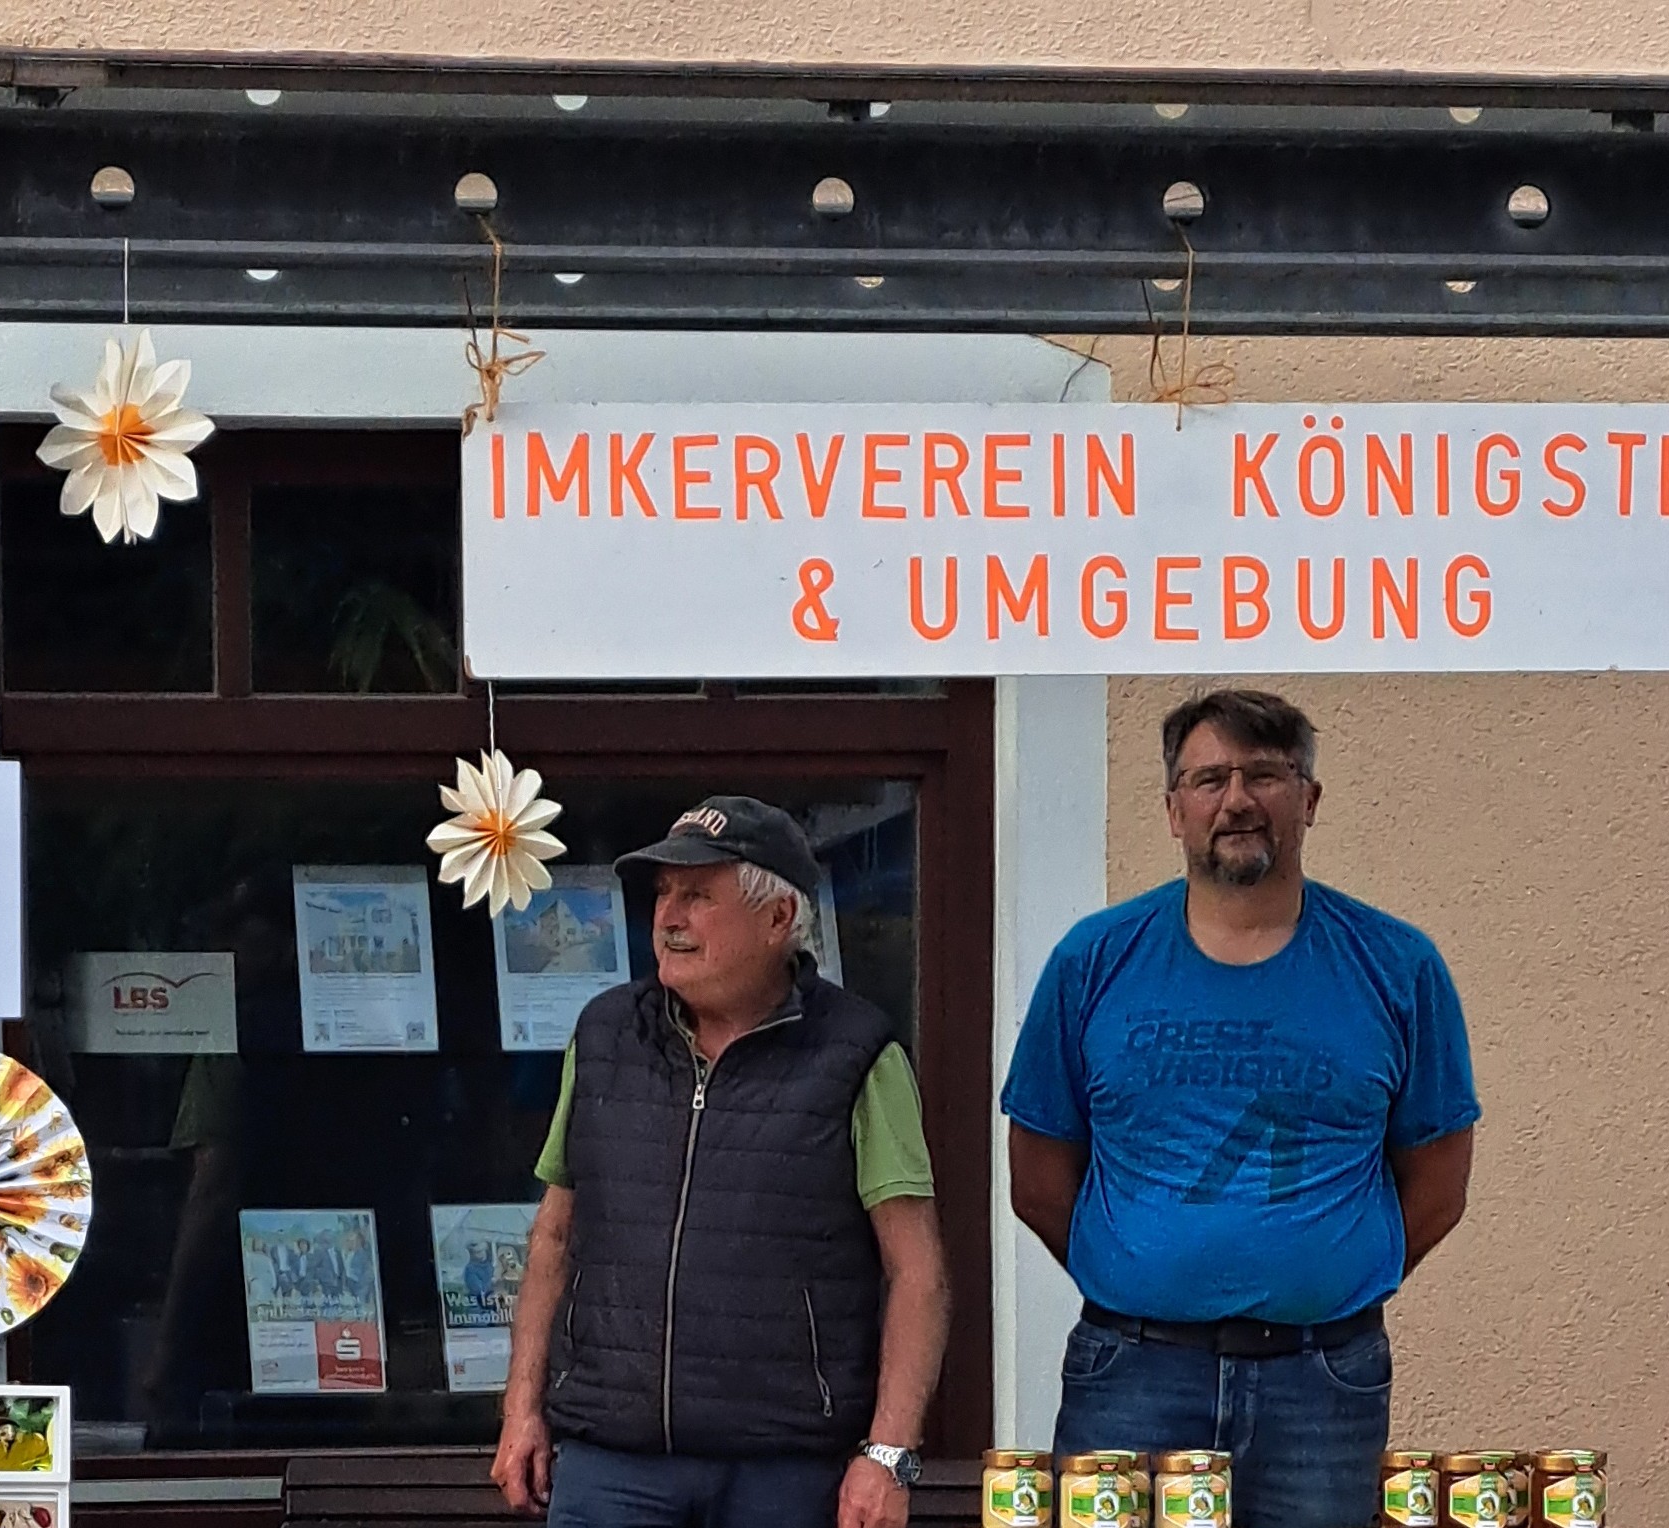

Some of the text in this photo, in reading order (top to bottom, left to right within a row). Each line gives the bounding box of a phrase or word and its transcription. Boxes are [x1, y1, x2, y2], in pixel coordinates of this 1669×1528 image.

[492, 432, 1135, 519] IMKERVEREIN
[792, 554, 1493, 641] & UMGEBUNG
[113, 986, 169, 1008] LBS
